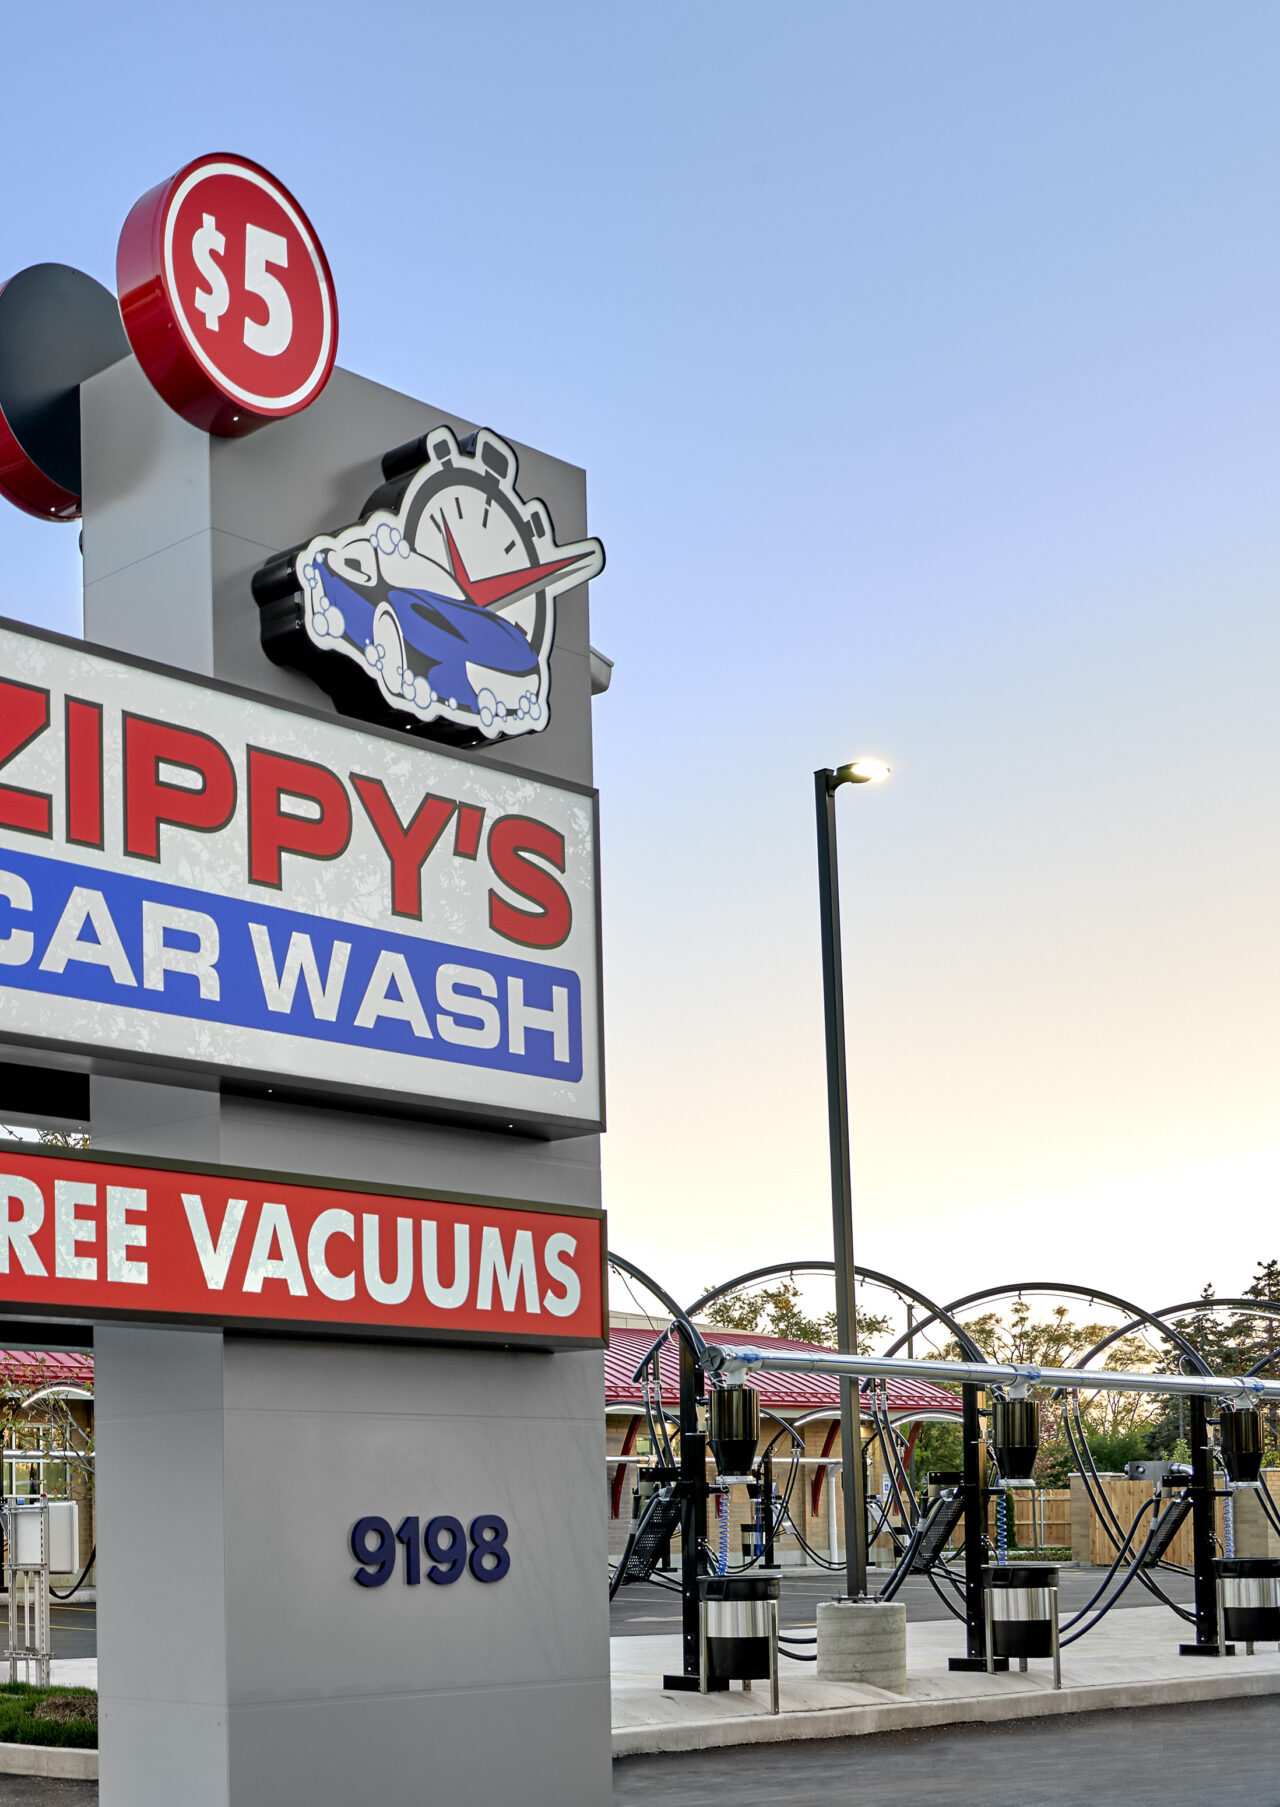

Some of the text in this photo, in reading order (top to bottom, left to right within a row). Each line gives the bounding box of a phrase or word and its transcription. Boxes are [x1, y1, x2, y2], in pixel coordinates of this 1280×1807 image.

[191, 212, 294, 357] $5
[248, 922, 570, 1063] WASH
[180, 1193, 581, 1318] VACUUMS
[350, 1514, 511, 1588] 9198
